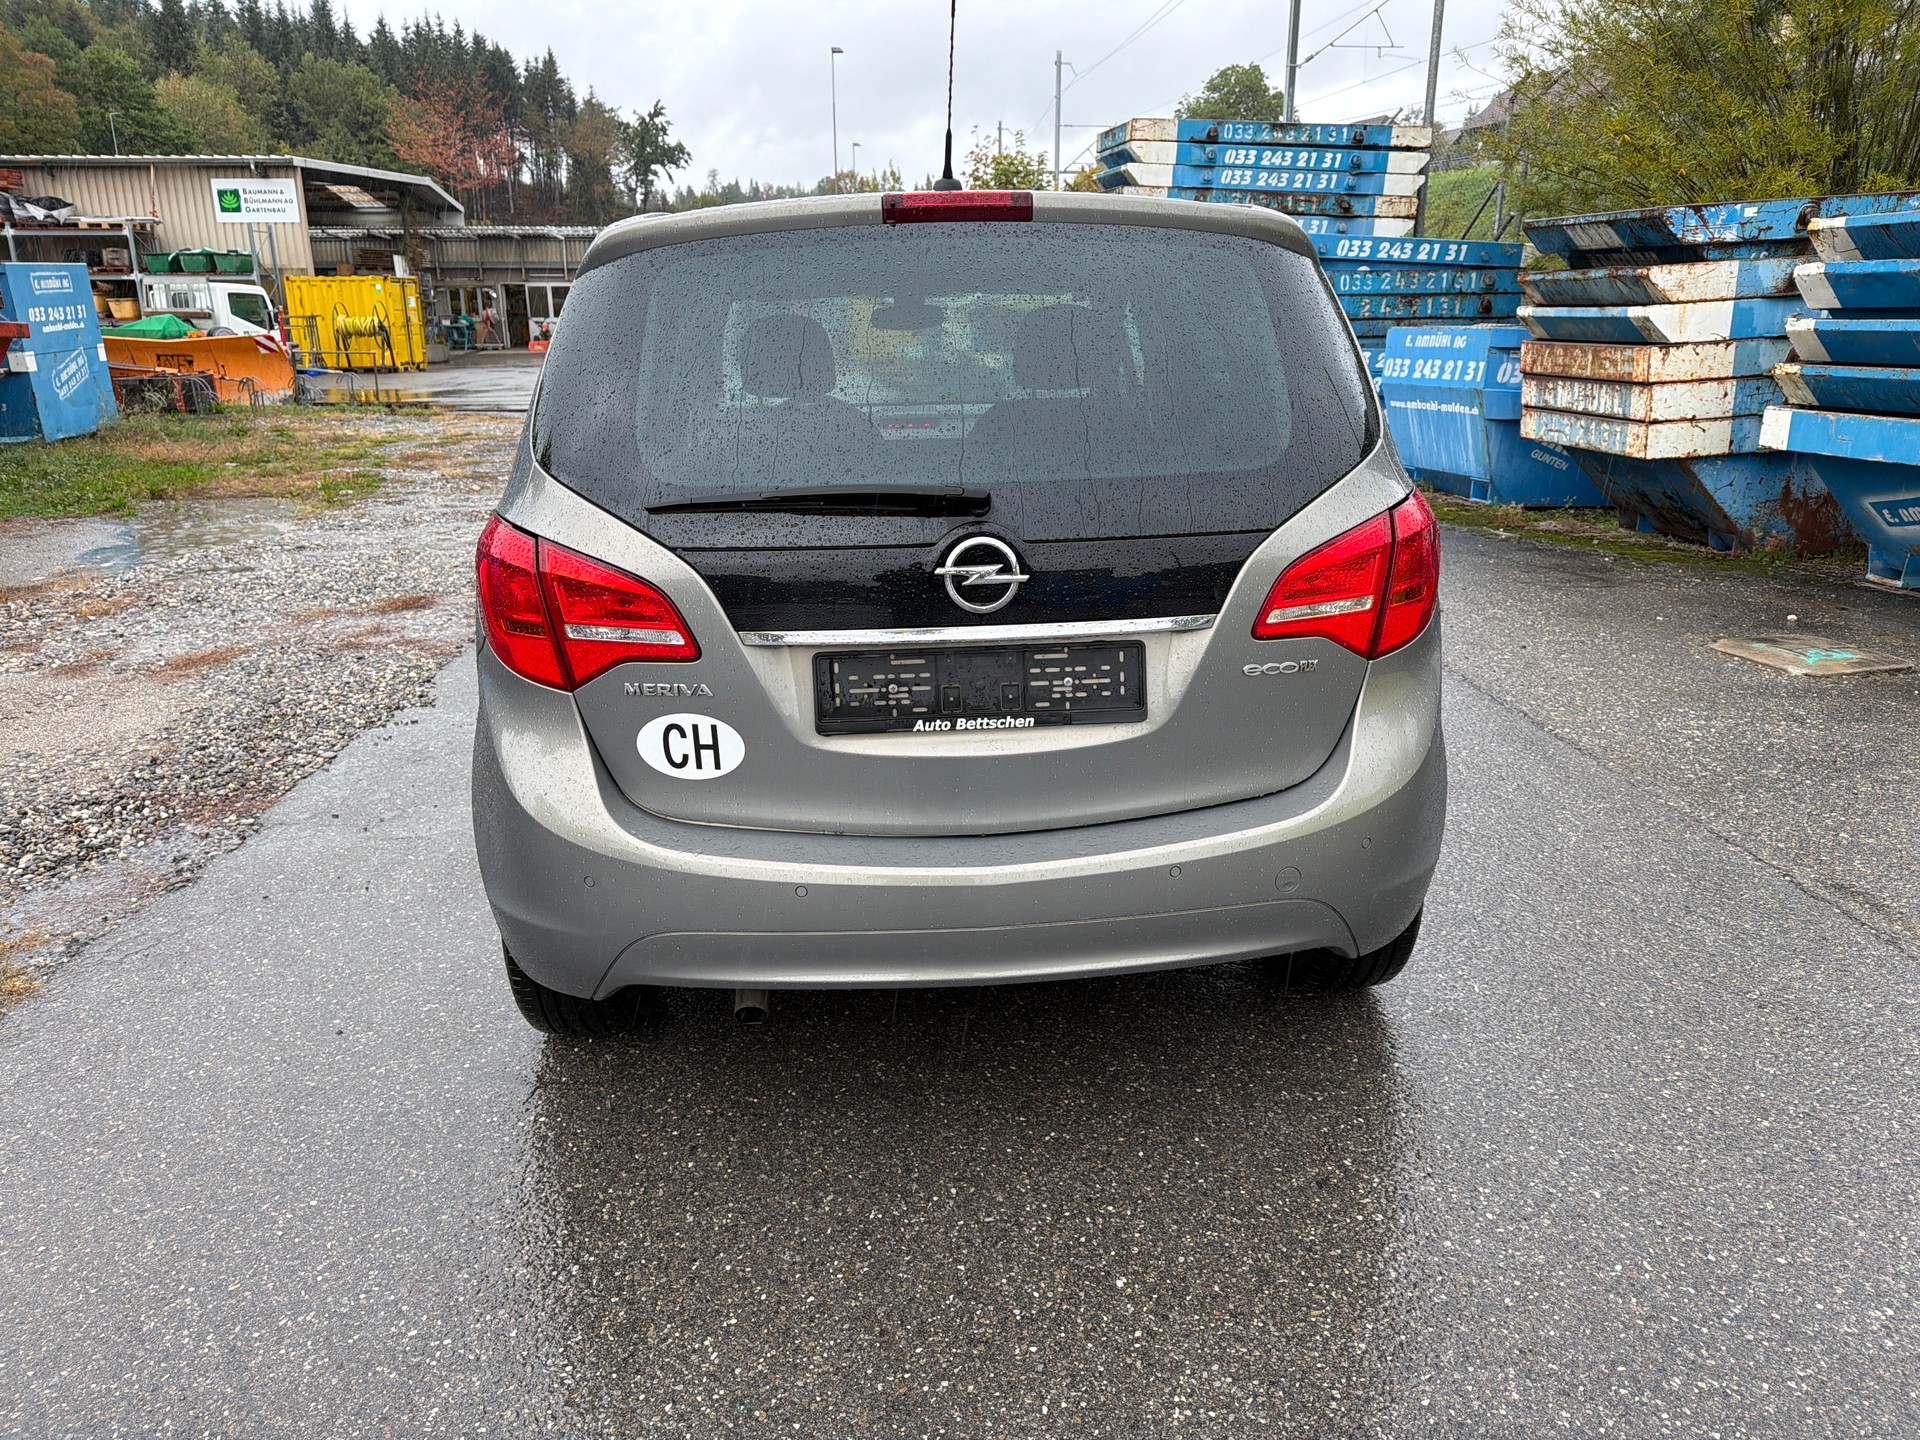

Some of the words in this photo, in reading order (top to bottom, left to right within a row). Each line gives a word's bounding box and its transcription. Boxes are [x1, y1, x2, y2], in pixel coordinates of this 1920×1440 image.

[1224, 124, 1254, 140] 033
[1328, 126, 1348, 142] 31
[1224, 149, 1258, 164] 033
[1260, 150, 1294, 166] 243
[1296, 151, 1318, 167] 21
[1321, 152, 1342, 168] 31
[1220, 169, 1253, 185] 033
[1256, 171, 1290, 187] 243
[1292, 173, 1313, 188] 21
[1316, 174, 1338, 189] 31
[1308, 220, 1328, 234] 31
[1336, 239, 1373, 257] 033
[1377, 241, 1414, 259] 243
[1416, 243, 1441, 261] 21
[1444, 244, 1469, 262] 31
[1340, 273, 1373, 291] 033
[1426, 272, 1448, 289] 21
[28, 306, 46, 322] 033
[48, 305, 65, 321] 243
[65, 305, 76, 320] 21
[77, 304, 87, 319] 31
[1405, 334, 1413, 347] E.
[1414, 332, 1451, 348] AMBÜHL
[1454, 335, 1467, 349] AG
[1384, 358, 1412, 378] 033
[1412, 359, 1442, 379] 243
[1442, 360, 1463, 381] 21
[1464, 361, 1486, 383] 31
[1531, 449, 1569, 471] GUNTEN
[1882, 508, 1900, 523] E.
[624, 682, 714, 697] MERIVA
[913, 719, 951, 732] Auto
[956, 716, 1035, 731] Bettschen
[663, 723, 721, 770] CH
